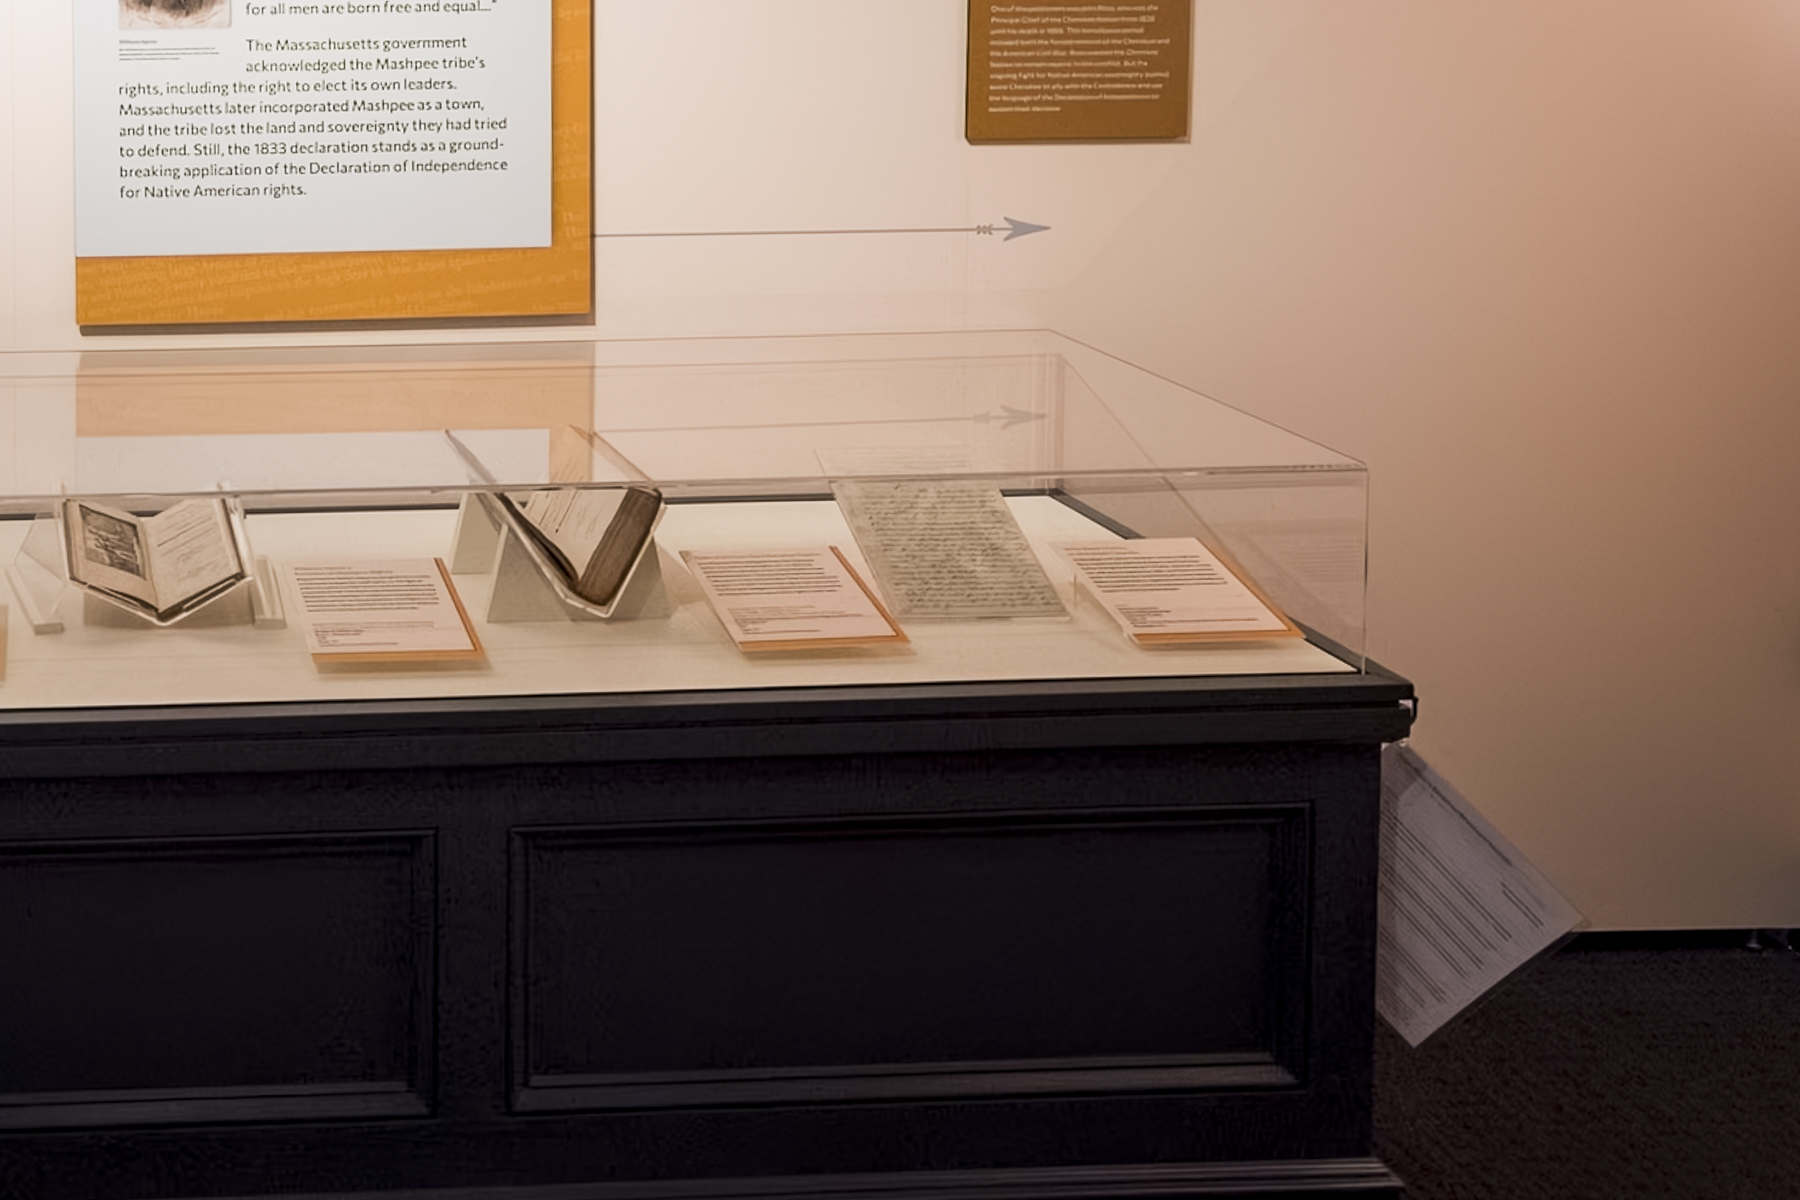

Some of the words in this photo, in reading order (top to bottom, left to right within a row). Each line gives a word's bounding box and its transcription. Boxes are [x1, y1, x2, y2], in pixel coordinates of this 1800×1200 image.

[119, 165, 180, 179] breaking
[183, 163, 261, 178] application
[264, 163, 279, 174] of
[283, 163, 306, 174] the
[309, 161, 390, 173] Declaration
[392, 160, 408, 172] of
[411, 159, 508, 173] Independence
[120, 186, 140, 198] for
[144, 185, 190, 197] Native
[193, 184, 260, 196] American
[263, 184, 306, 198] rights.
